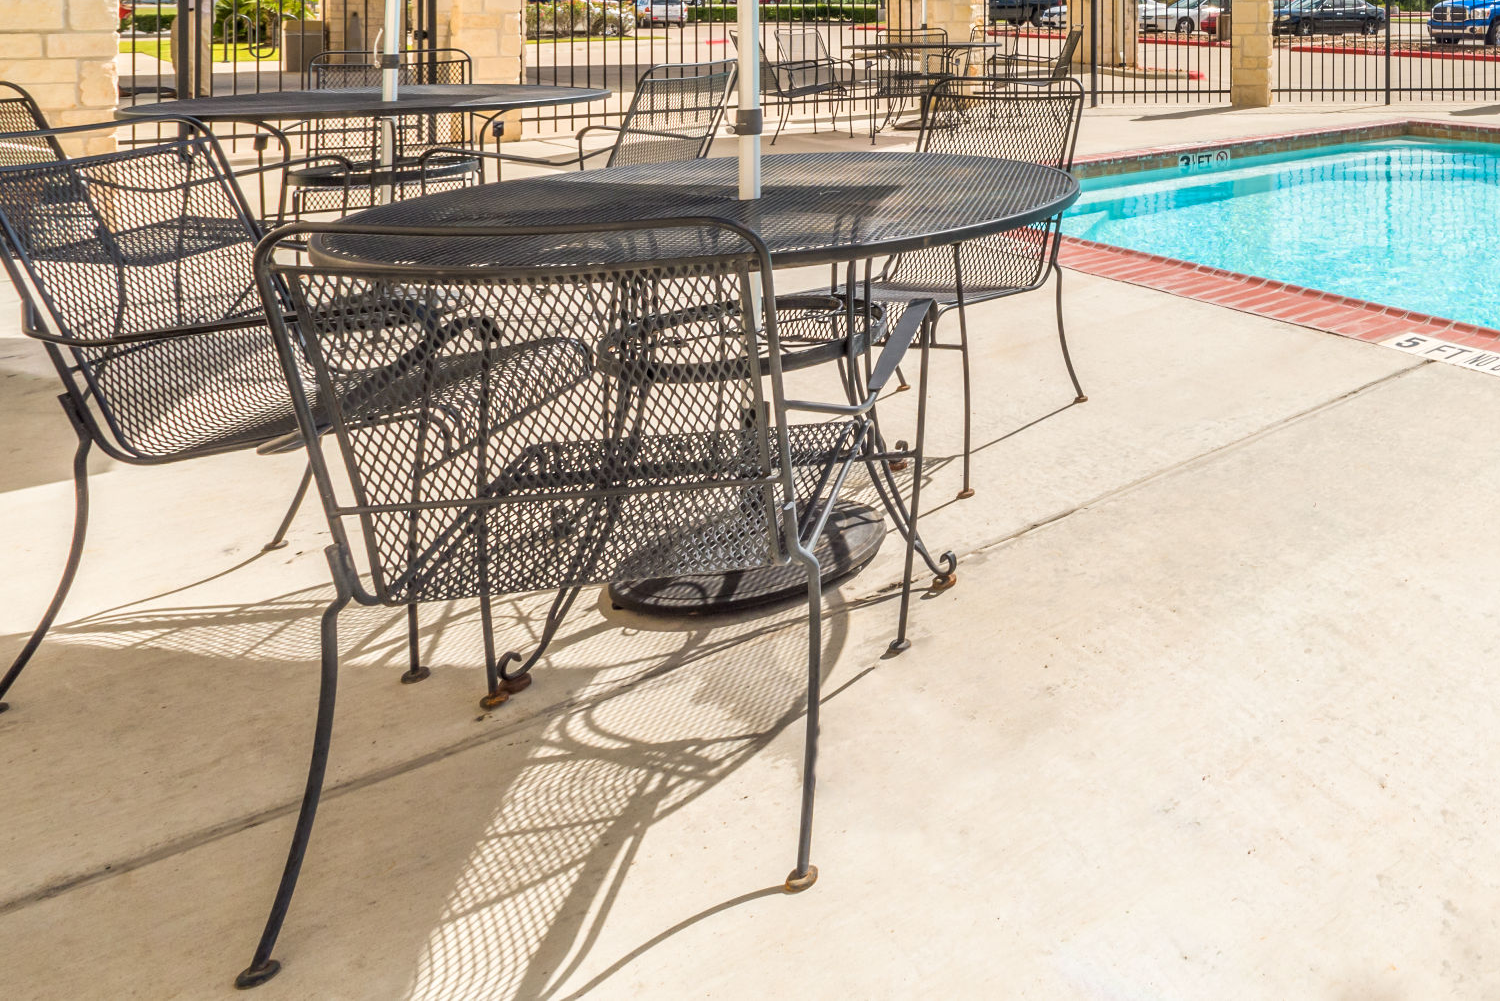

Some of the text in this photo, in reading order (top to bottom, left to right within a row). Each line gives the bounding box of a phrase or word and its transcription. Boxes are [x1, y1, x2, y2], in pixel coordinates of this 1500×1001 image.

[1395, 337, 1427, 348] 5
[1425, 344, 1473, 360] FT
[1465, 352, 1500, 367] NO
